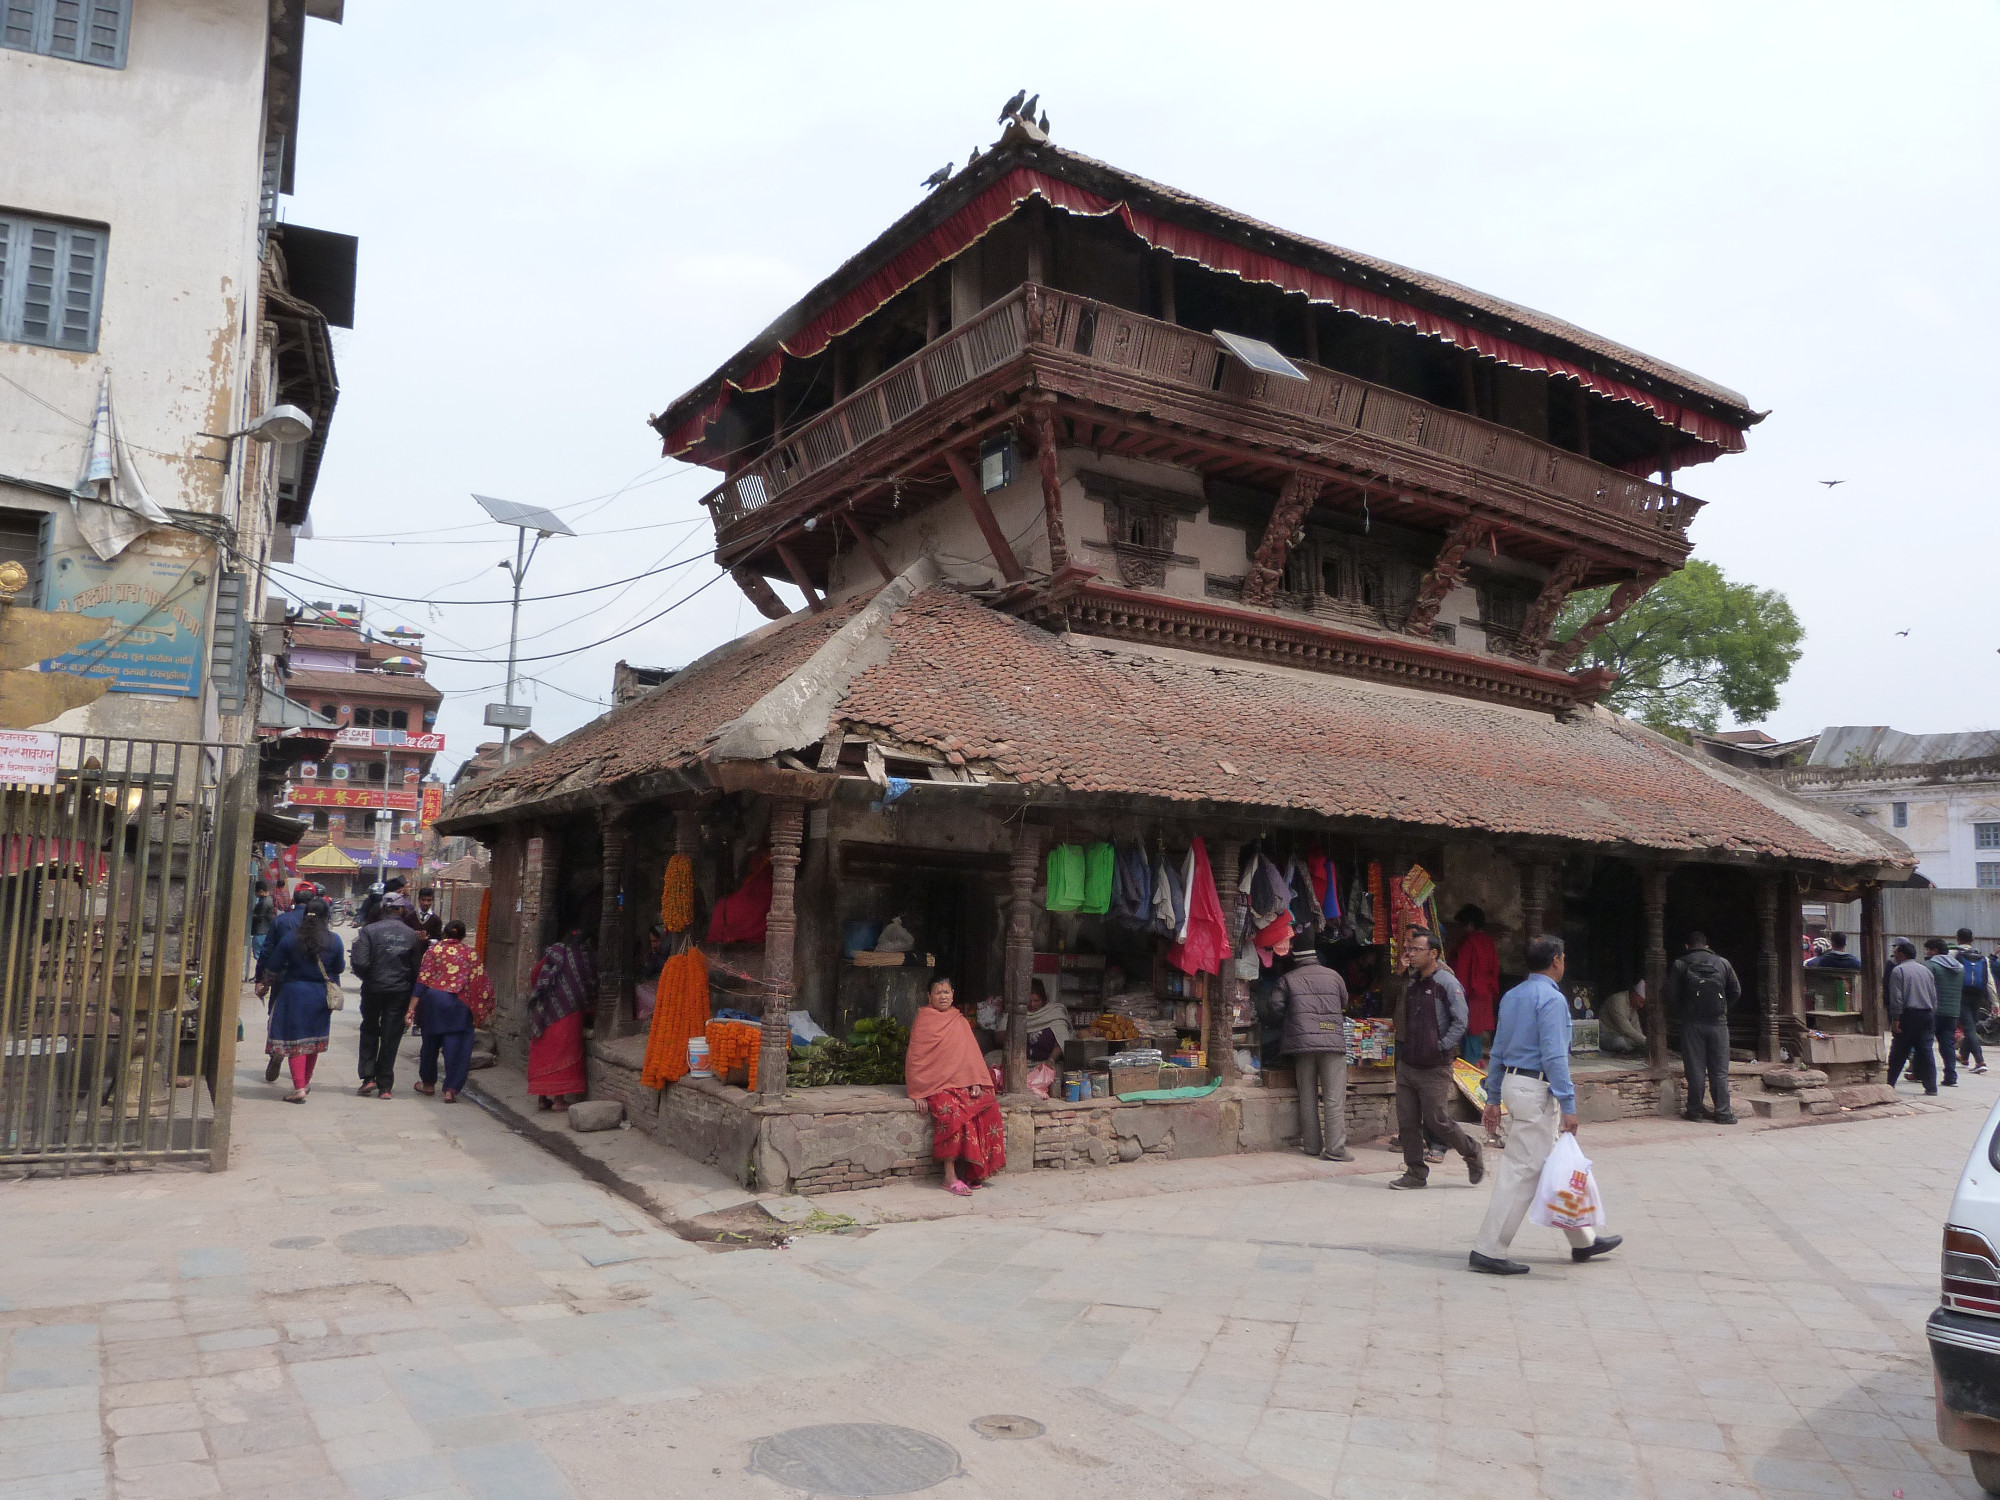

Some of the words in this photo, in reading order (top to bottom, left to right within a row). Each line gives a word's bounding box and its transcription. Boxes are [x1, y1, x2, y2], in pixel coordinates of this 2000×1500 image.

[73, 580, 112, 613] लक्ष्मी
[172, 603, 202, 639] बाजा
[351, 730, 370, 738] CAFE
[406, 734, 443, 749] ca-Cola
[21, 748, 55, 761] सावधान
[291, 789, 371, 806] 和平餐厅
